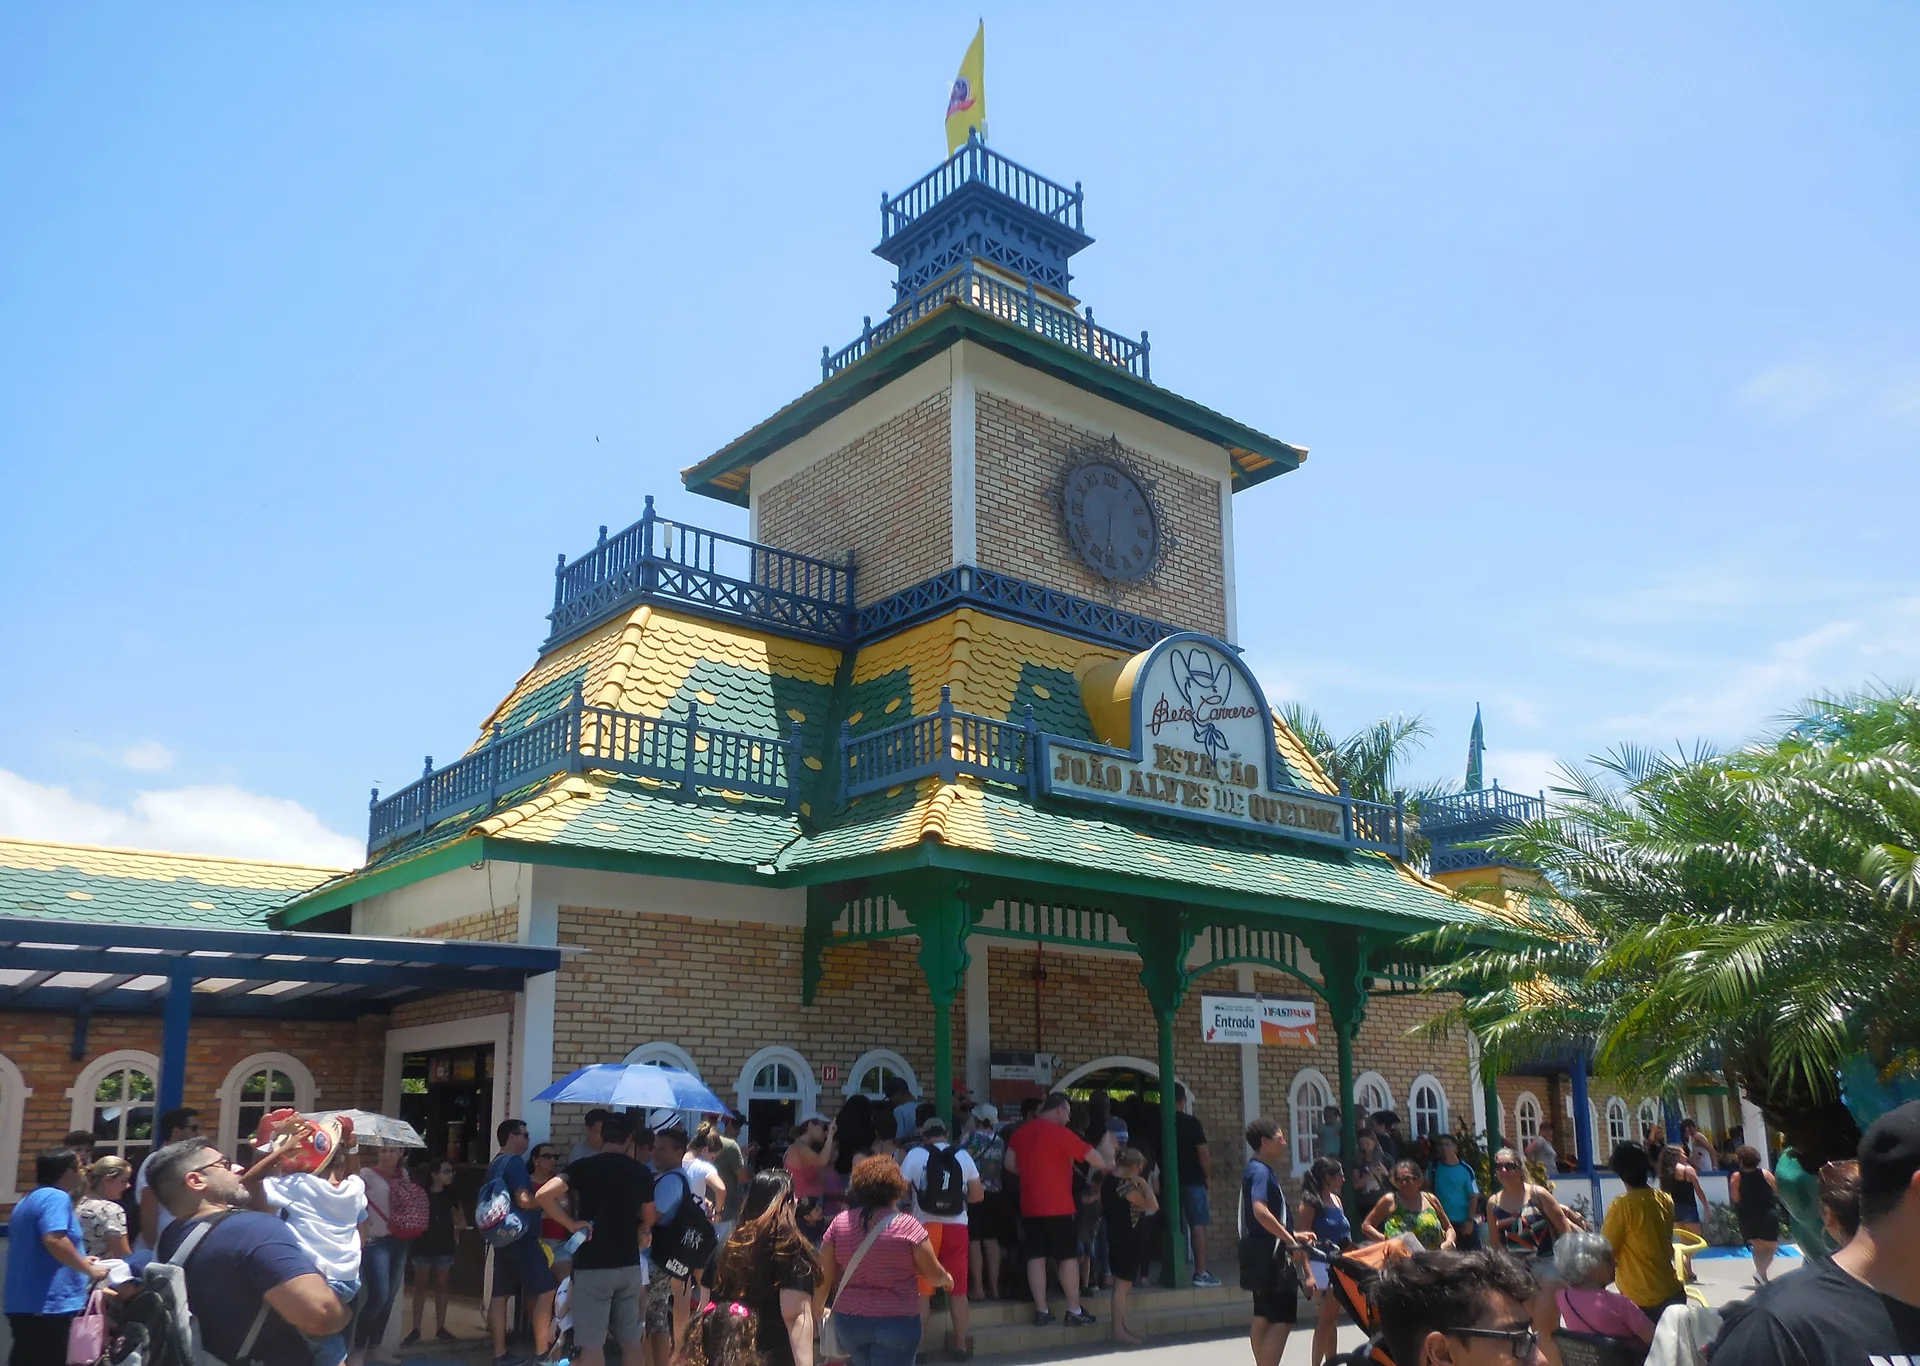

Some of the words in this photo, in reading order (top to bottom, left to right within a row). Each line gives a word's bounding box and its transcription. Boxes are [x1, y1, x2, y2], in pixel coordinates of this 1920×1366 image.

[1145, 692, 1195, 736] Beto
[1196, 695, 1260, 722] Carrero
[1054, 753, 1122, 792] JOÃO
[1126, 769, 1212, 809] ALVES
[1213, 785, 1245, 816] DE
[1248, 793, 1341, 834] QUEIROZ
[1215, 1014, 1255, 1029] Entrada
[1224, 1029, 1248, 1037] Entrance
